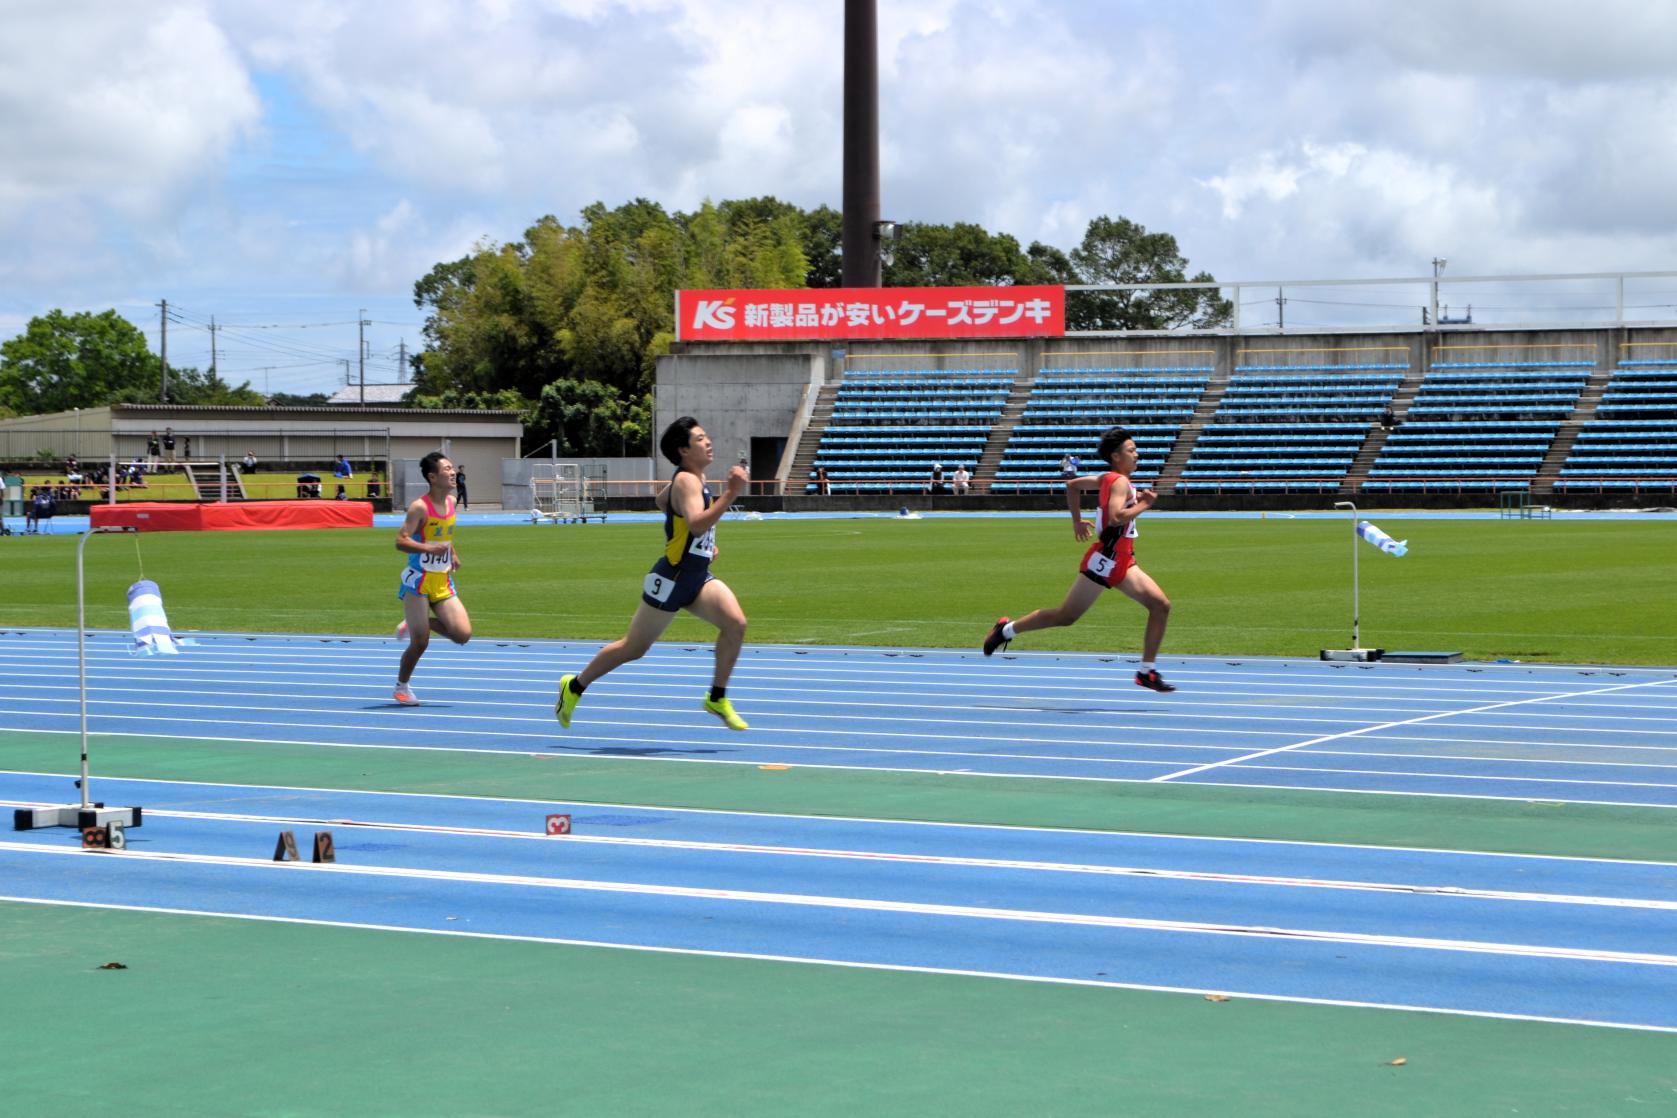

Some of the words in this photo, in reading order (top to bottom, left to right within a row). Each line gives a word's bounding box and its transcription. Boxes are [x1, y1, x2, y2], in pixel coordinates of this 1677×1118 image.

[744, 298, 1051, 328] 新製品が安いケーズデンキ
[405, 569, 414, 583] 7
[1096, 558, 1108, 572] 5
[651, 578, 662, 595] 9
[109, 820, 125, 849] 5
[319, 832, 335, 860] 2
